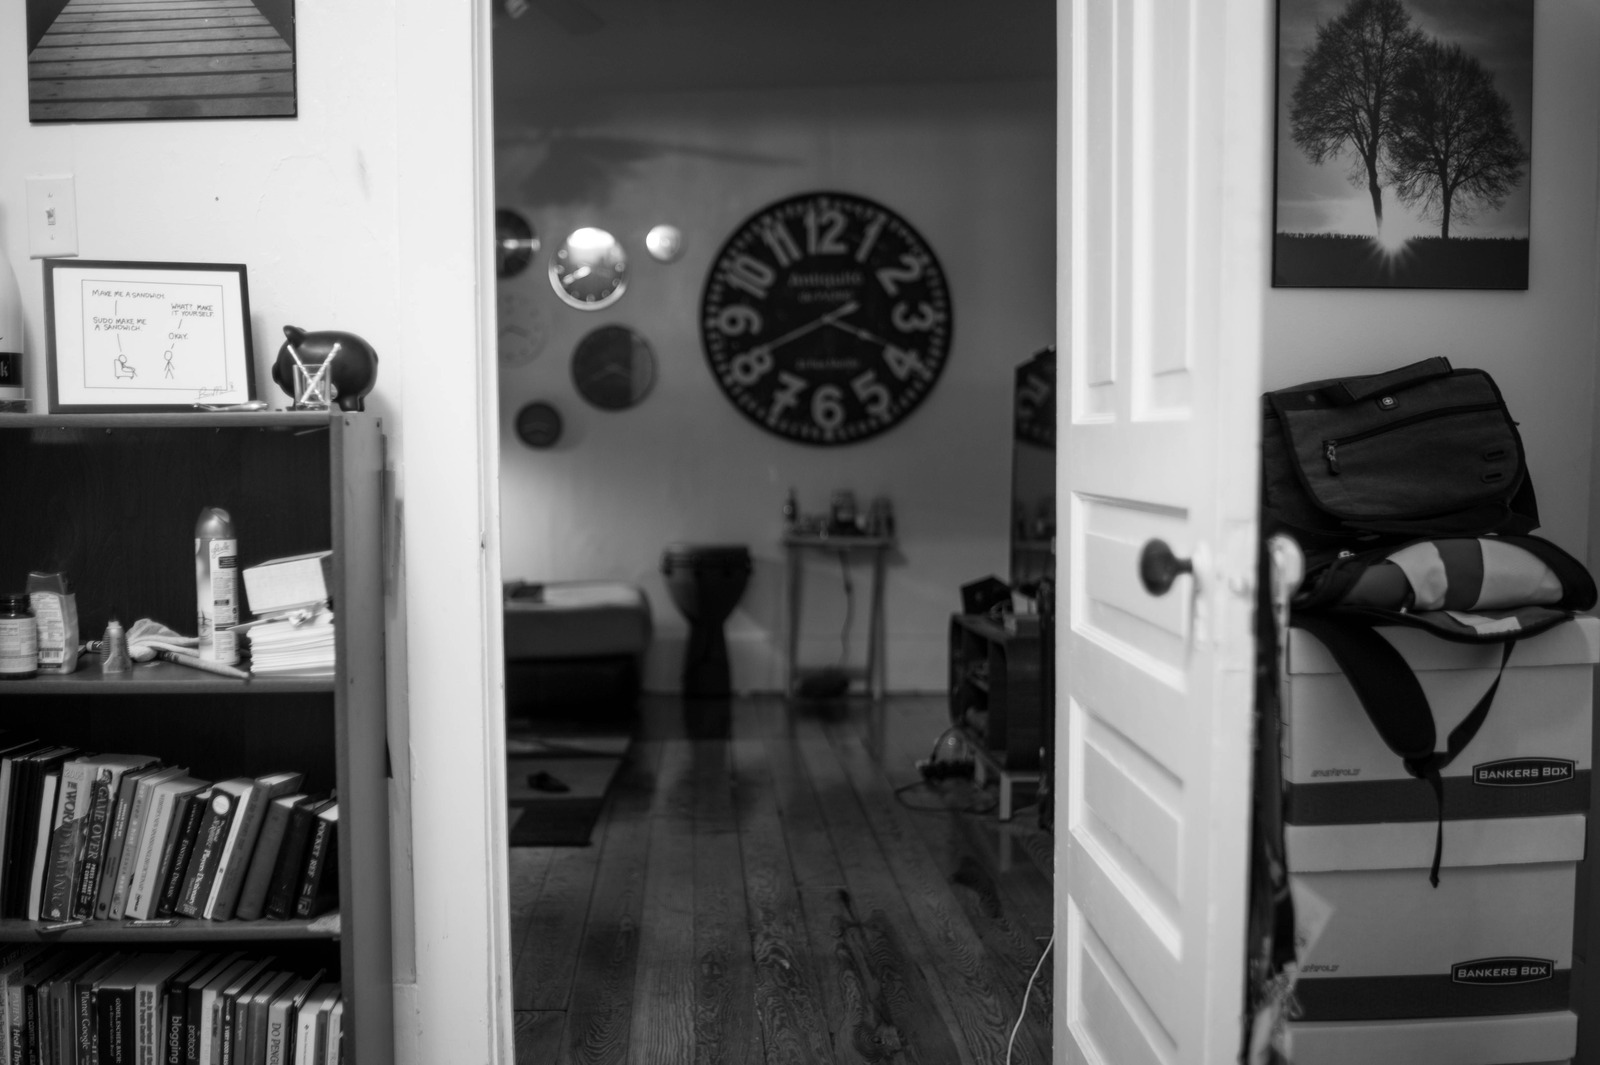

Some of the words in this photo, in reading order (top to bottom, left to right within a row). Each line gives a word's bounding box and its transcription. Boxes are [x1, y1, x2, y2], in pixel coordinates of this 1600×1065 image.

[761, 220, 803, 268] 11
[804, 208, 848, 256] 12
[855, 213, 888, 263] 1
[725, 254, 776, 299] 10
[876, 254, 923, 296] 2
[718, 305, 762, 336] 9
[891, 300, 935, 333] 3
[732, 346, 774, 386] 8
[882, 343, 925, 380] 4
[770, 370, 810, 423] 7
[810, 384, 844, 429] 6
[851, 369, 890, 415] 5
[1479, 768, 1539, 779] BANKERS
[1542, 767, 1568, 776] BOX
[62, 790, 78, 838] WORLD
[95, 786, 109, 822] GAME
[88, 824, 103, 860] OVER
[175, 839, 189, 870] EINSTEIN'S
[312, 821, 326, 857] POCKET
[166, 872, 180, 898] DREAMS
[1458, 967, 1518, 978] BANKERS
[1521, 966, 1547, 975] BOX
[81, 992, 90, 1016] Planet
[80, 1018, 90, 1049] Google
[169, 1016, 182, 1063] blogging
[188, 1025, 196, 1060] protocol
[272, 1023, 281, 1037] DO
